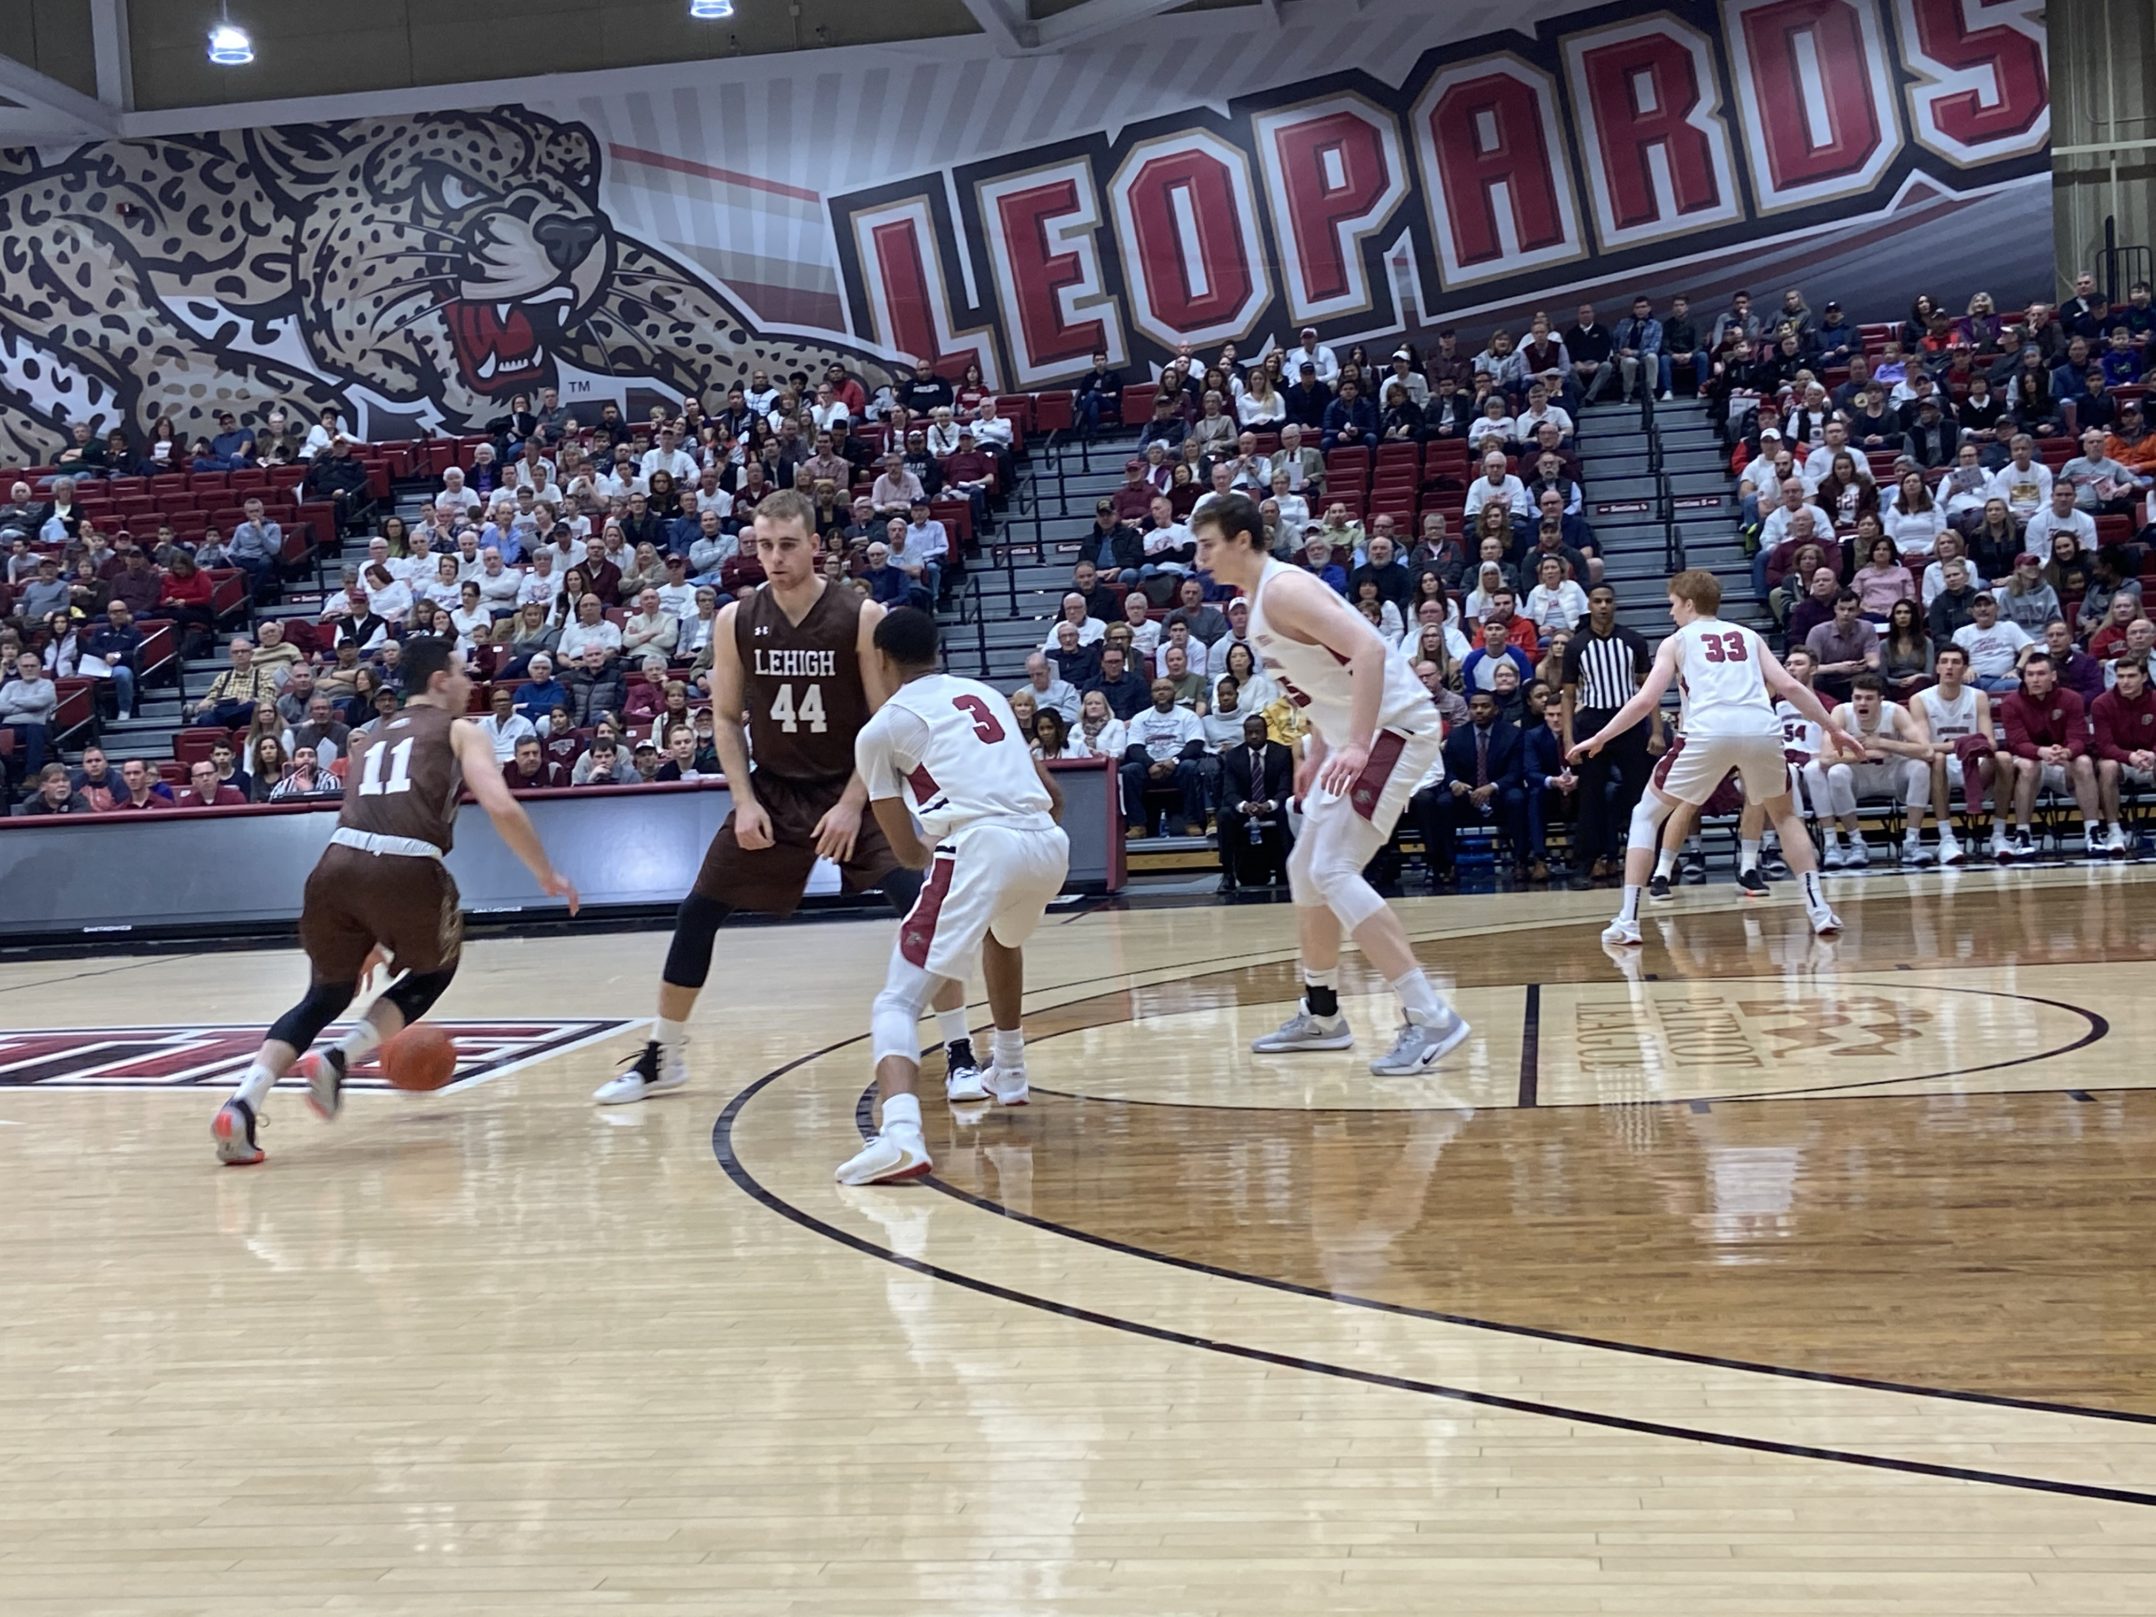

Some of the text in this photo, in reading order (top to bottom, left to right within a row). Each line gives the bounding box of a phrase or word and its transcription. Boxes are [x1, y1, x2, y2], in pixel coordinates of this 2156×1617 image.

[852, 0, 2050, 388] LEOPARDS
[568, 380, 590, 392] TM
[754, 649, 836, 676] LEHIGH
[1700, 630, 1748, 663] 33
[770, 683, 828, 733] 44
[952, 694, 1006, 744] 3
[1784, 724, 1807, 742] 54
[358, 736, 415, 796] 11
[1575, 1000, 1662, 1073] LEAGUE
[1654, 996, 1764, 1068] PATRIOT
